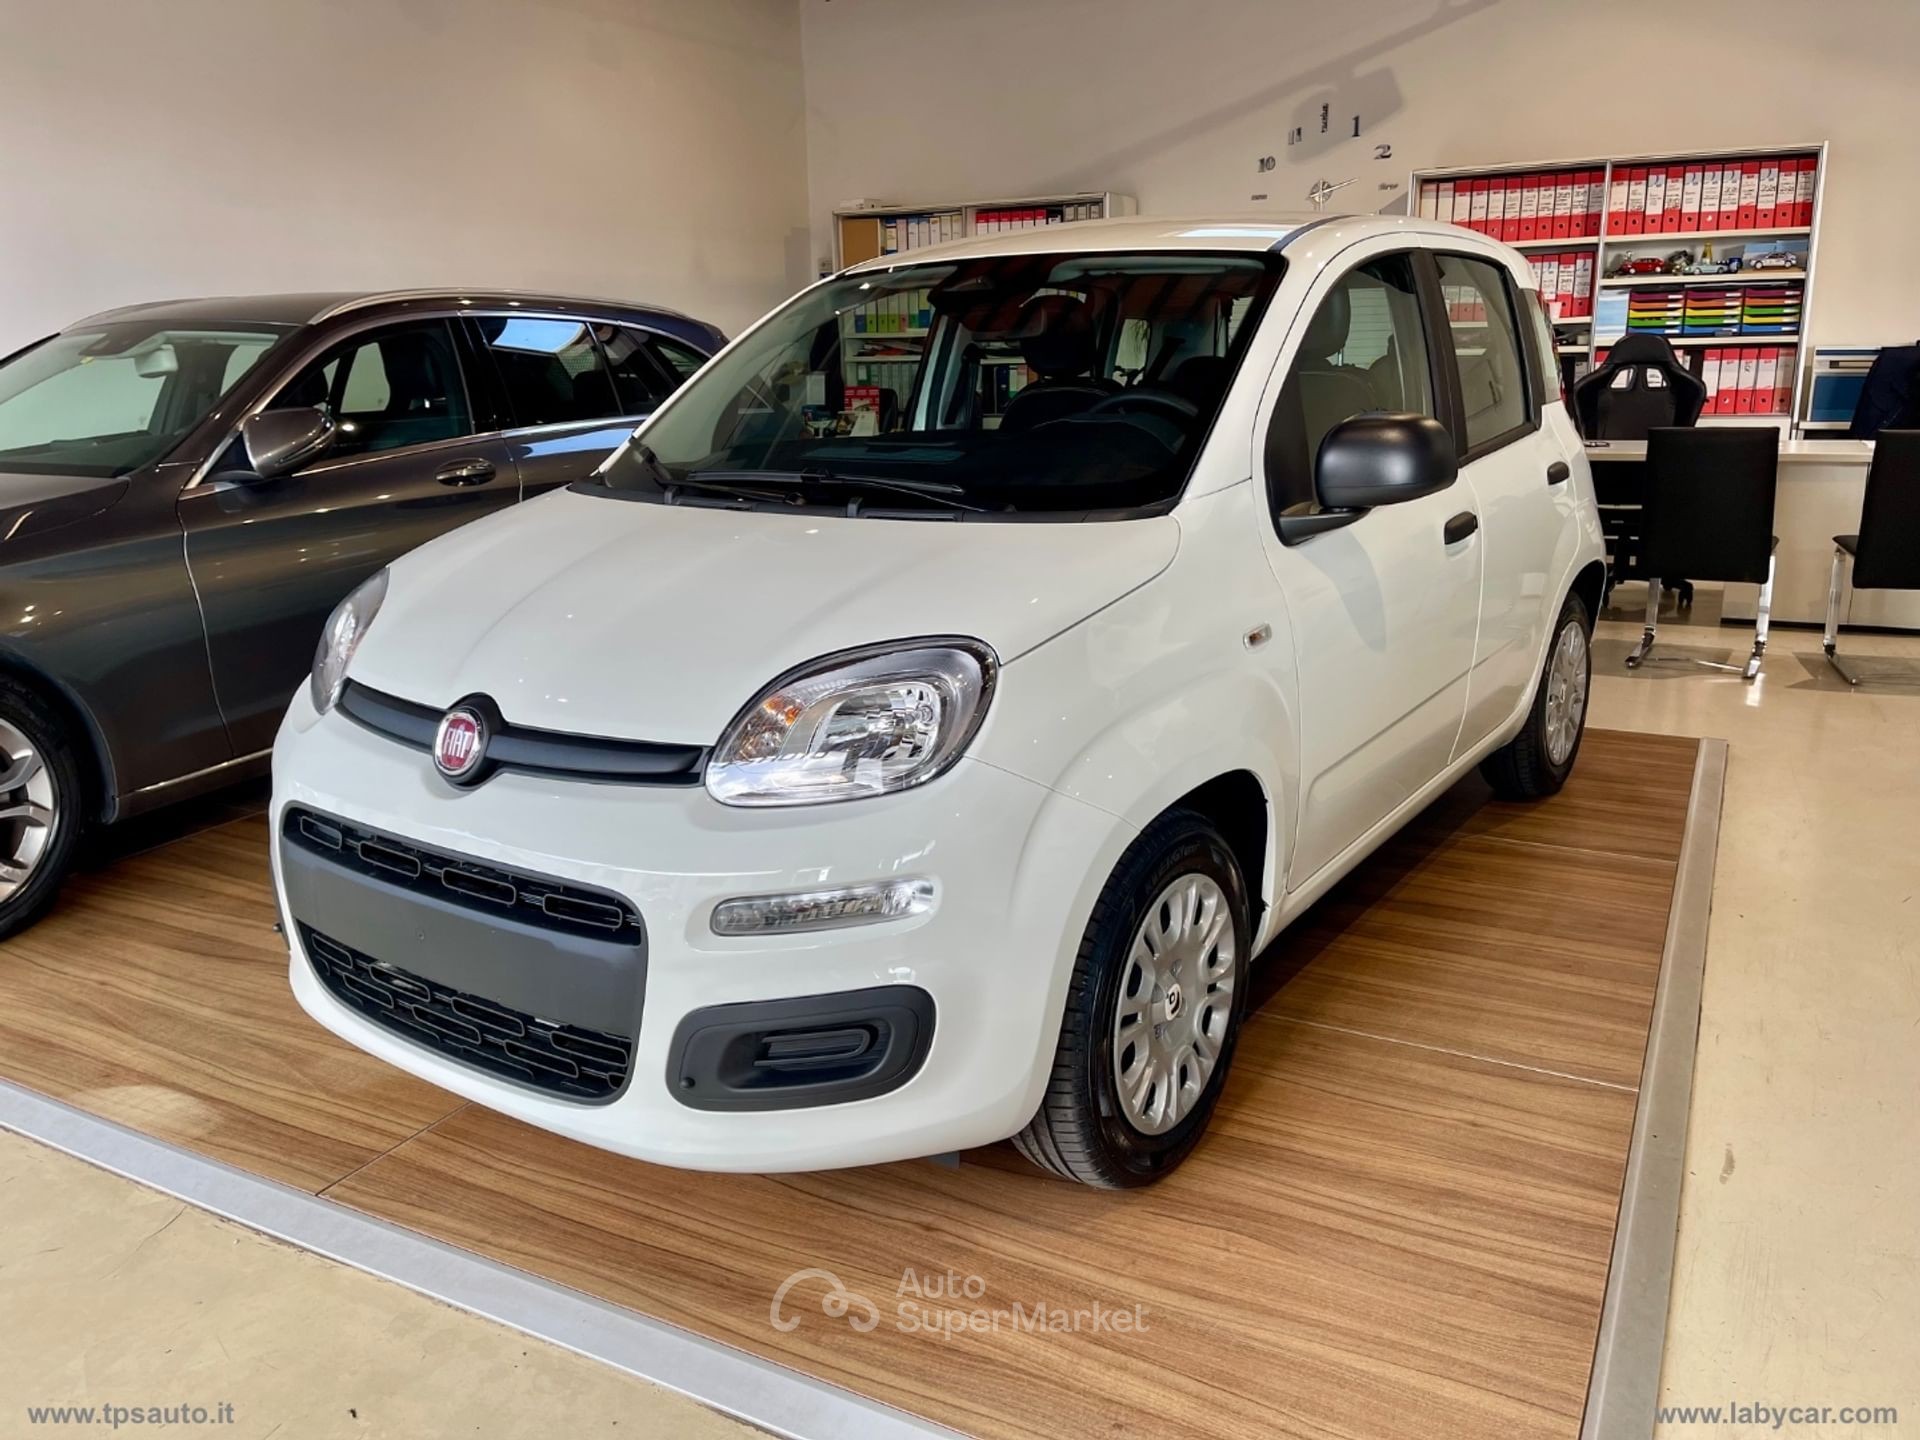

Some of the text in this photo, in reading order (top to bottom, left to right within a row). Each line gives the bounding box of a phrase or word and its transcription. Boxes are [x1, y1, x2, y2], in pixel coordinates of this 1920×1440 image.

[1352, 115, 1360, 137] 1
[1374, 144, 1392, 160] 2
[1257, 156, 1276, 173] 10
[442, 723, 475, 759] FIAT
